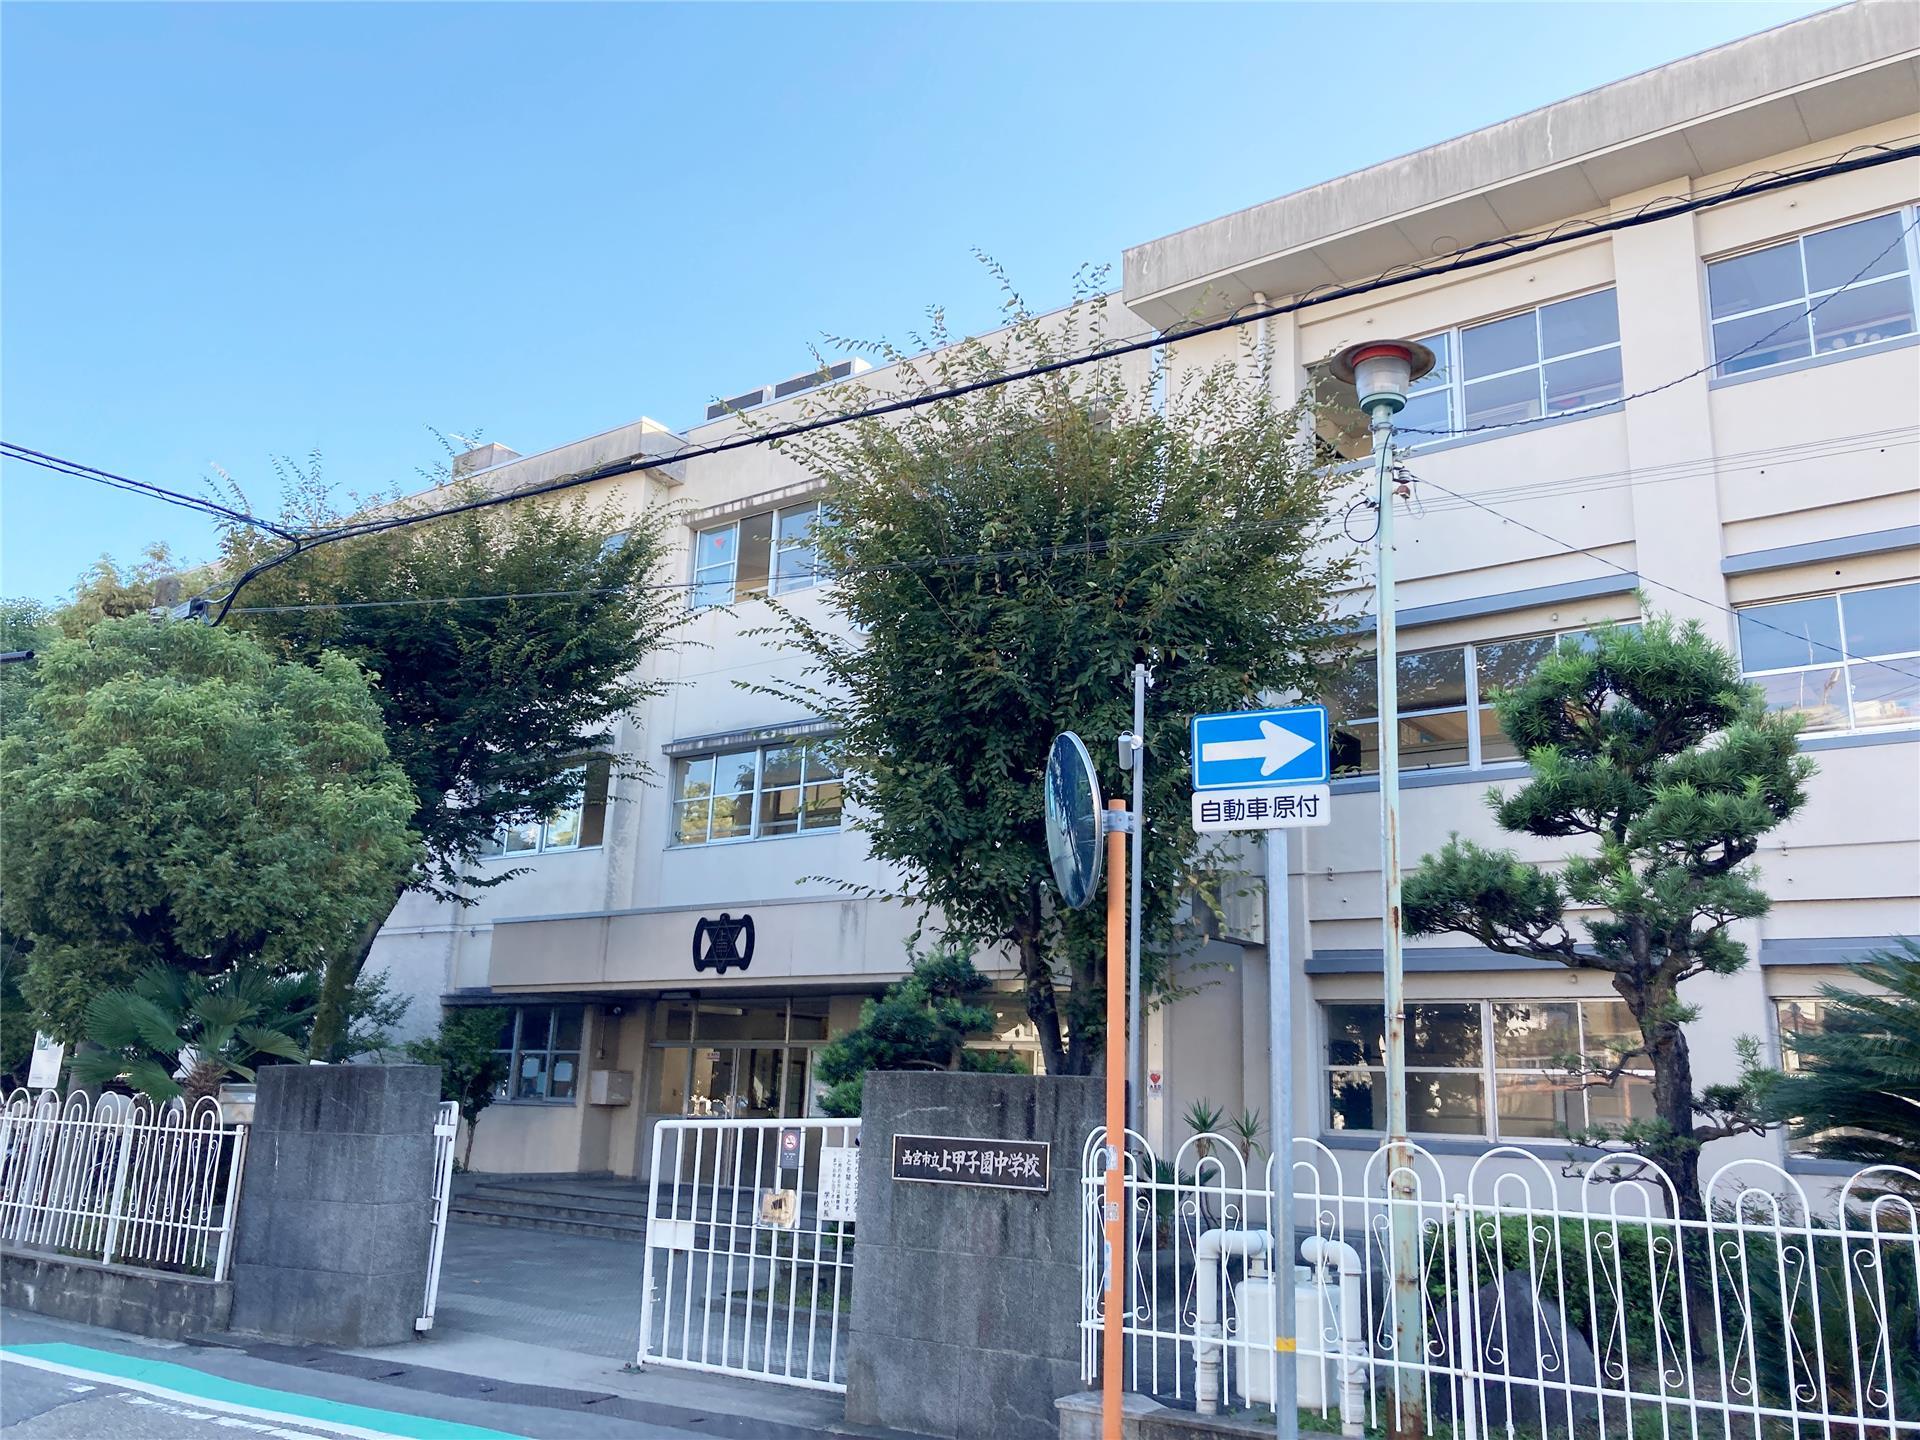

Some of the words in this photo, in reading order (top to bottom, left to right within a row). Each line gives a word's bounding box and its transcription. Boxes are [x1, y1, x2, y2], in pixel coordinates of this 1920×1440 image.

[1201, 794, 1320, 823] 自動車・原付
[901, 1149, 1041, 1178] 西宮市立上甲子園中学校
